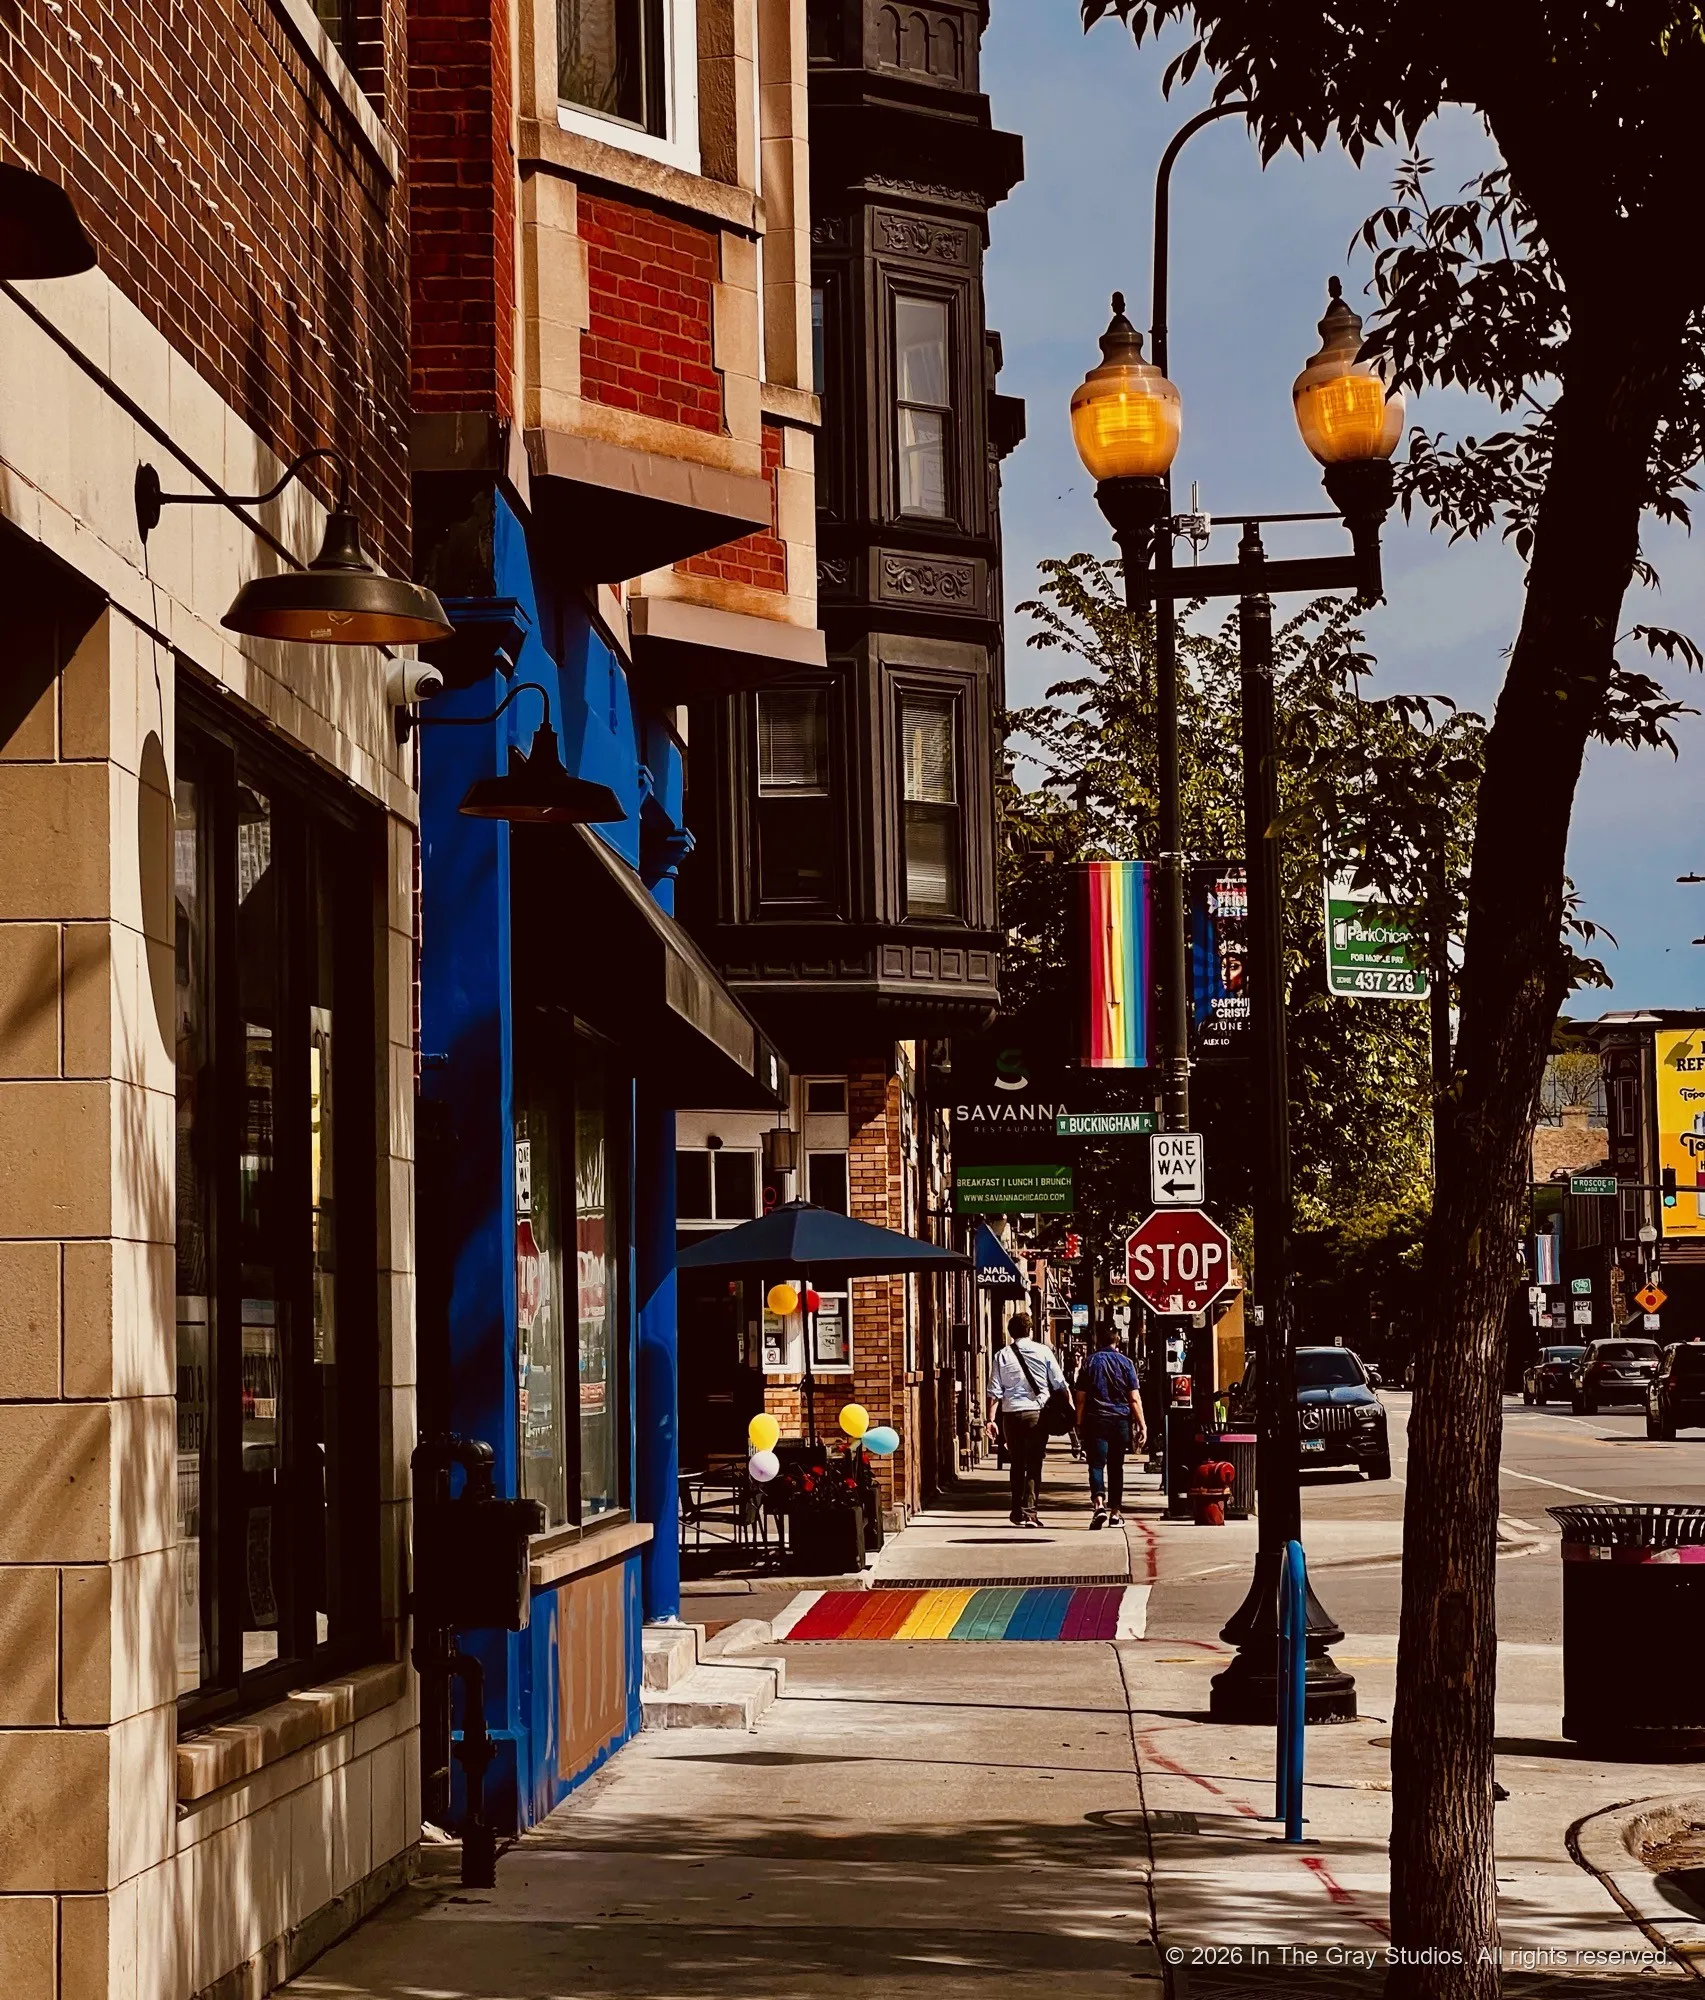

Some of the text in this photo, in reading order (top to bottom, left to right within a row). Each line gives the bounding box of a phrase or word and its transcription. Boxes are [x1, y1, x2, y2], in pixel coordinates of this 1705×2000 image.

[1217, 906, 1241, 917] FEST
[1350, 953, 1364, 961] FOR
[1391, 955, 1404, 964] PAY
[1355, 971, 1383, 990] 437
[1387, 973, 1415, 992] 219
[1213, 1021, 1242, 1031] JUNE
[1203, 1038, 1219, 1046] ALEX
[956, 1104, 1068, 1121] SAVANNA
[974, 1125, 1053, 1133] RESTAURANT
[1069, 1116, 1140, 1133] BUCKINGHAM
[1144, 1119, 1153, 1128] PL
[1158, 1141, 1195, 1156] ONE
[1158, 1159, 1196, 1175] WAY
[957, 1177, 1071, 1187] BREAKFAST LUNCH BRUNCH
[964, 1193, 1065, 1202] WWW.SAVANNACHICAGO.COM
[1134, 1243, 1222, 1280] STOP
[983, 1266, 1009, 1274] NAIL
[977, 1274, 1015, 1283] SALON
